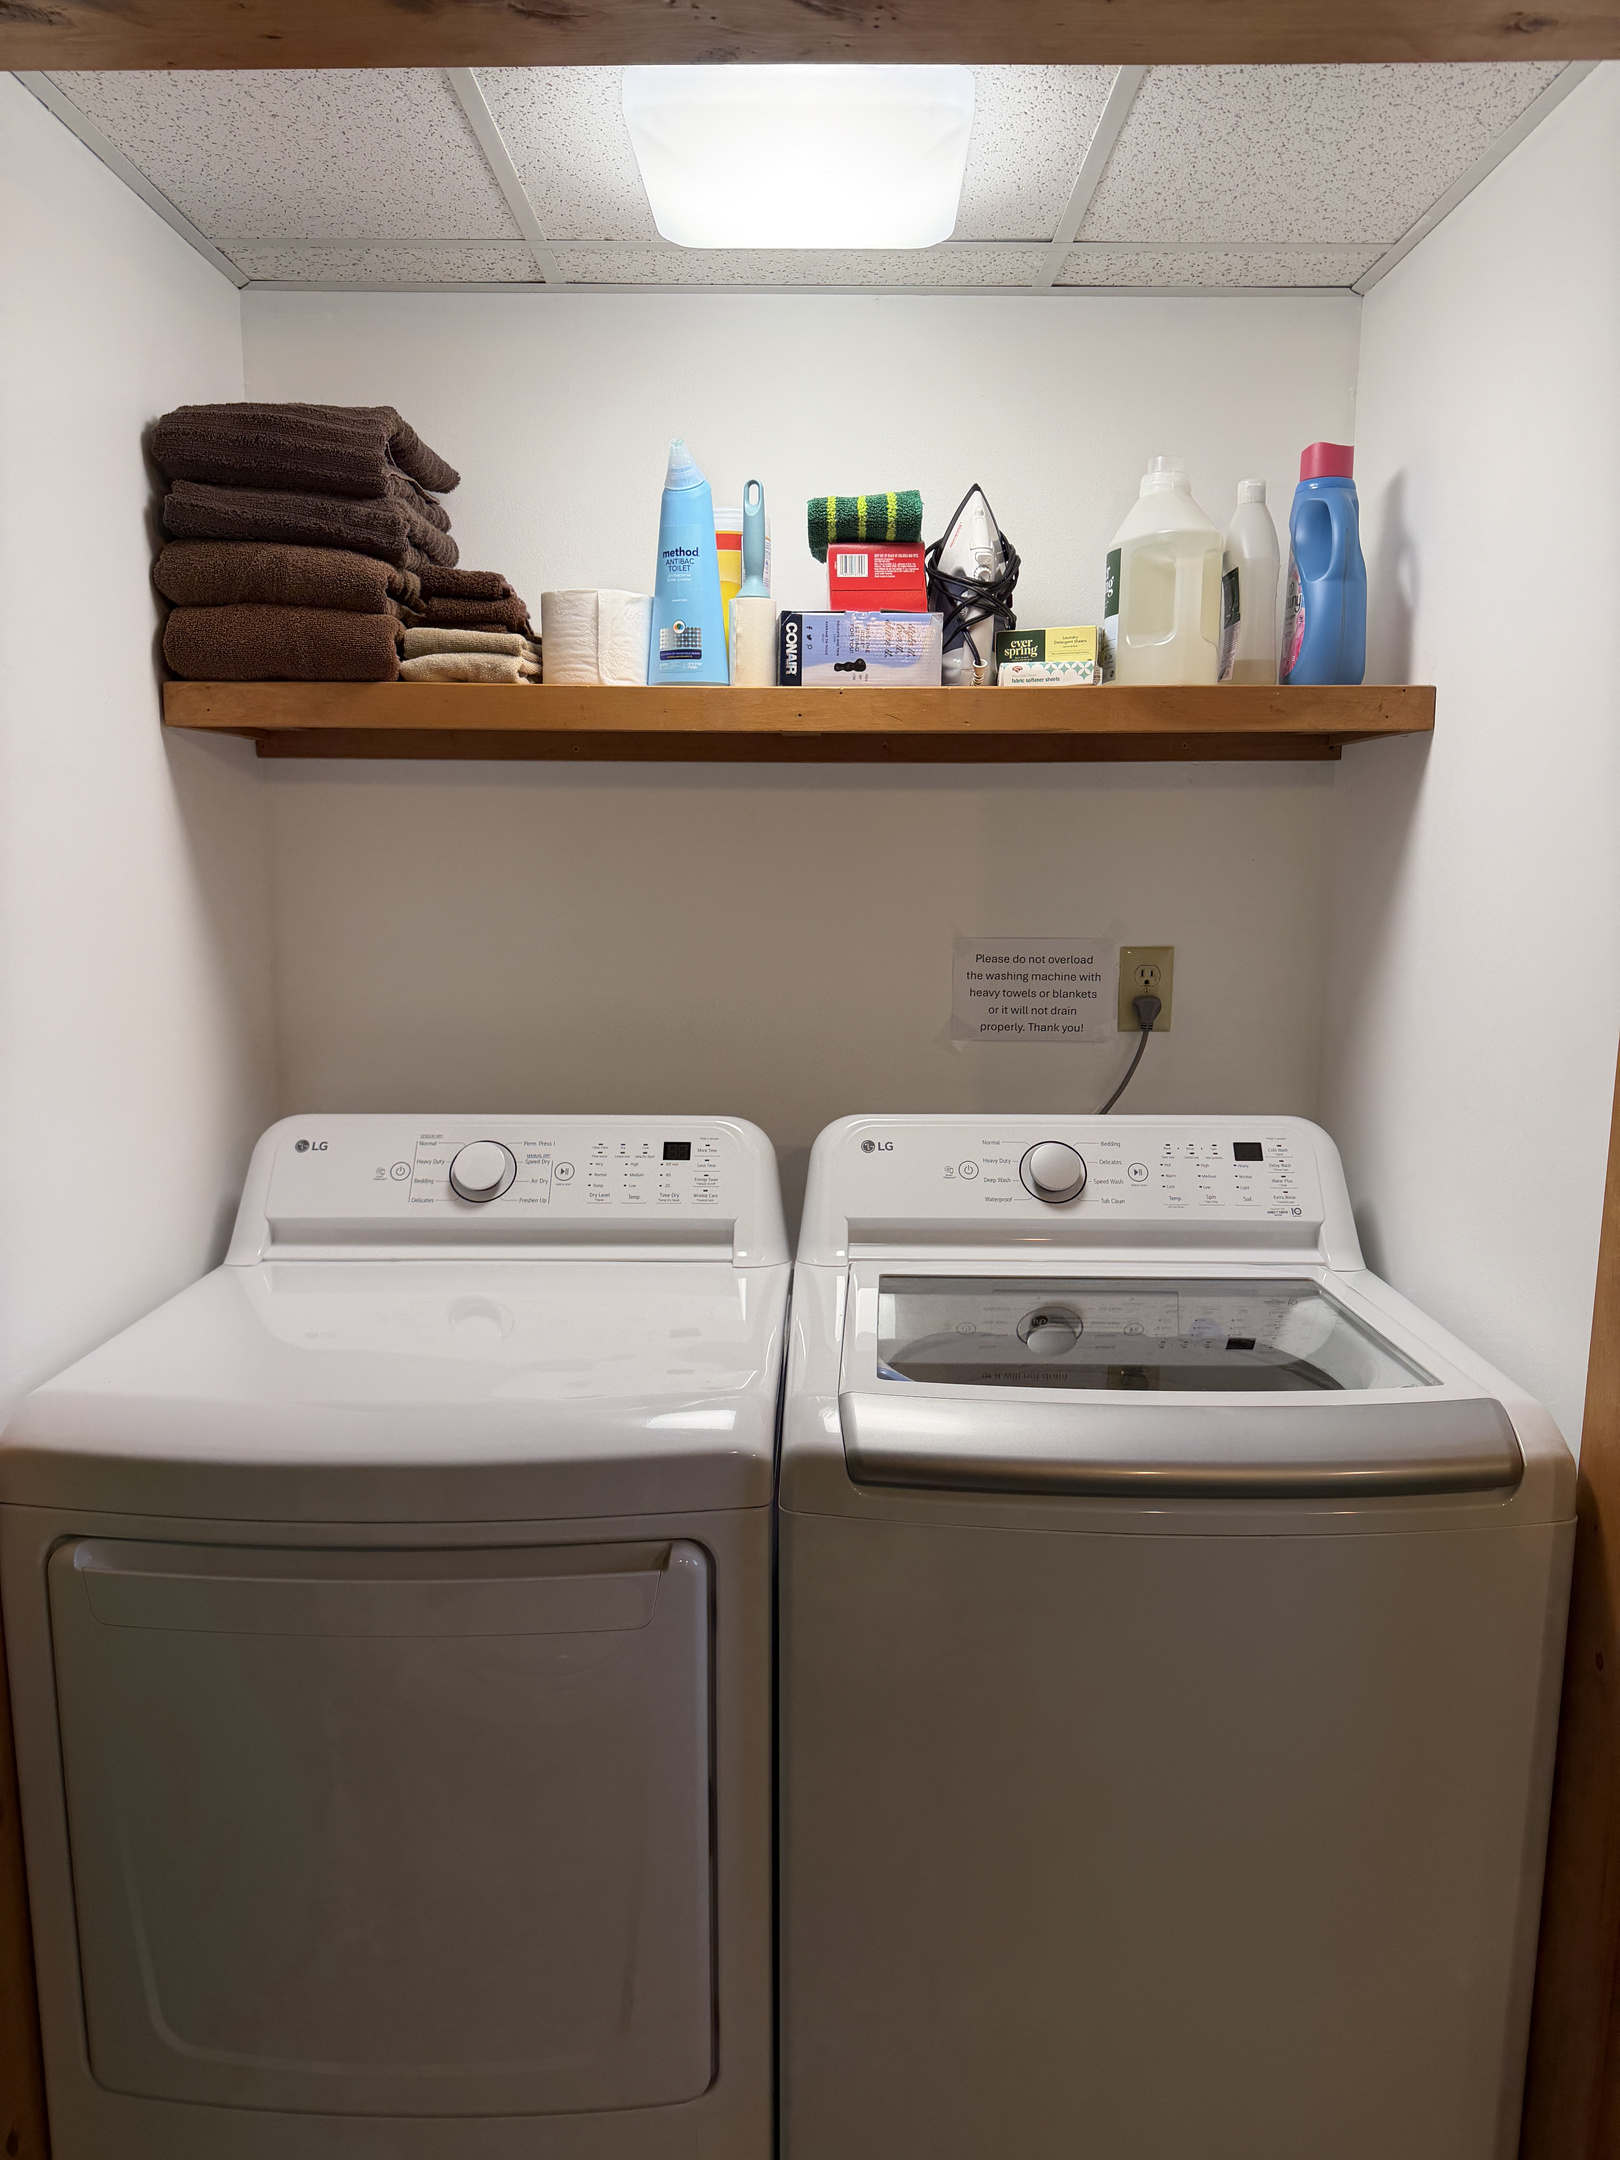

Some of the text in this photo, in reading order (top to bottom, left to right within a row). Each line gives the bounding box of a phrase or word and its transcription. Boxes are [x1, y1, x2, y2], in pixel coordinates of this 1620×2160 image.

[662, 547, 699, 558] method
[665, 558, 694, 566] ANTIBAC
[1010, 638, 1033, 648] ever
[786, 622, 798, 676] CONAIR
[1004, 645, 1038, 659] spring
[975, 954, 1094, 965] Please do not overload
[966, 971, 1102, 983] the washing machine with
[969, 988, 1000, 999] heavy
[1002, 988, 1036, 998] towels
[1052, 989, 1097, 999] blankets
[988, 1005, 1077, 1015] or it will not drain
[980, 1022, 1084, 1034] properly. Thank you!
[311, 1141, 328, 1151] LG
[877, 1141, 894, 1151] LG
